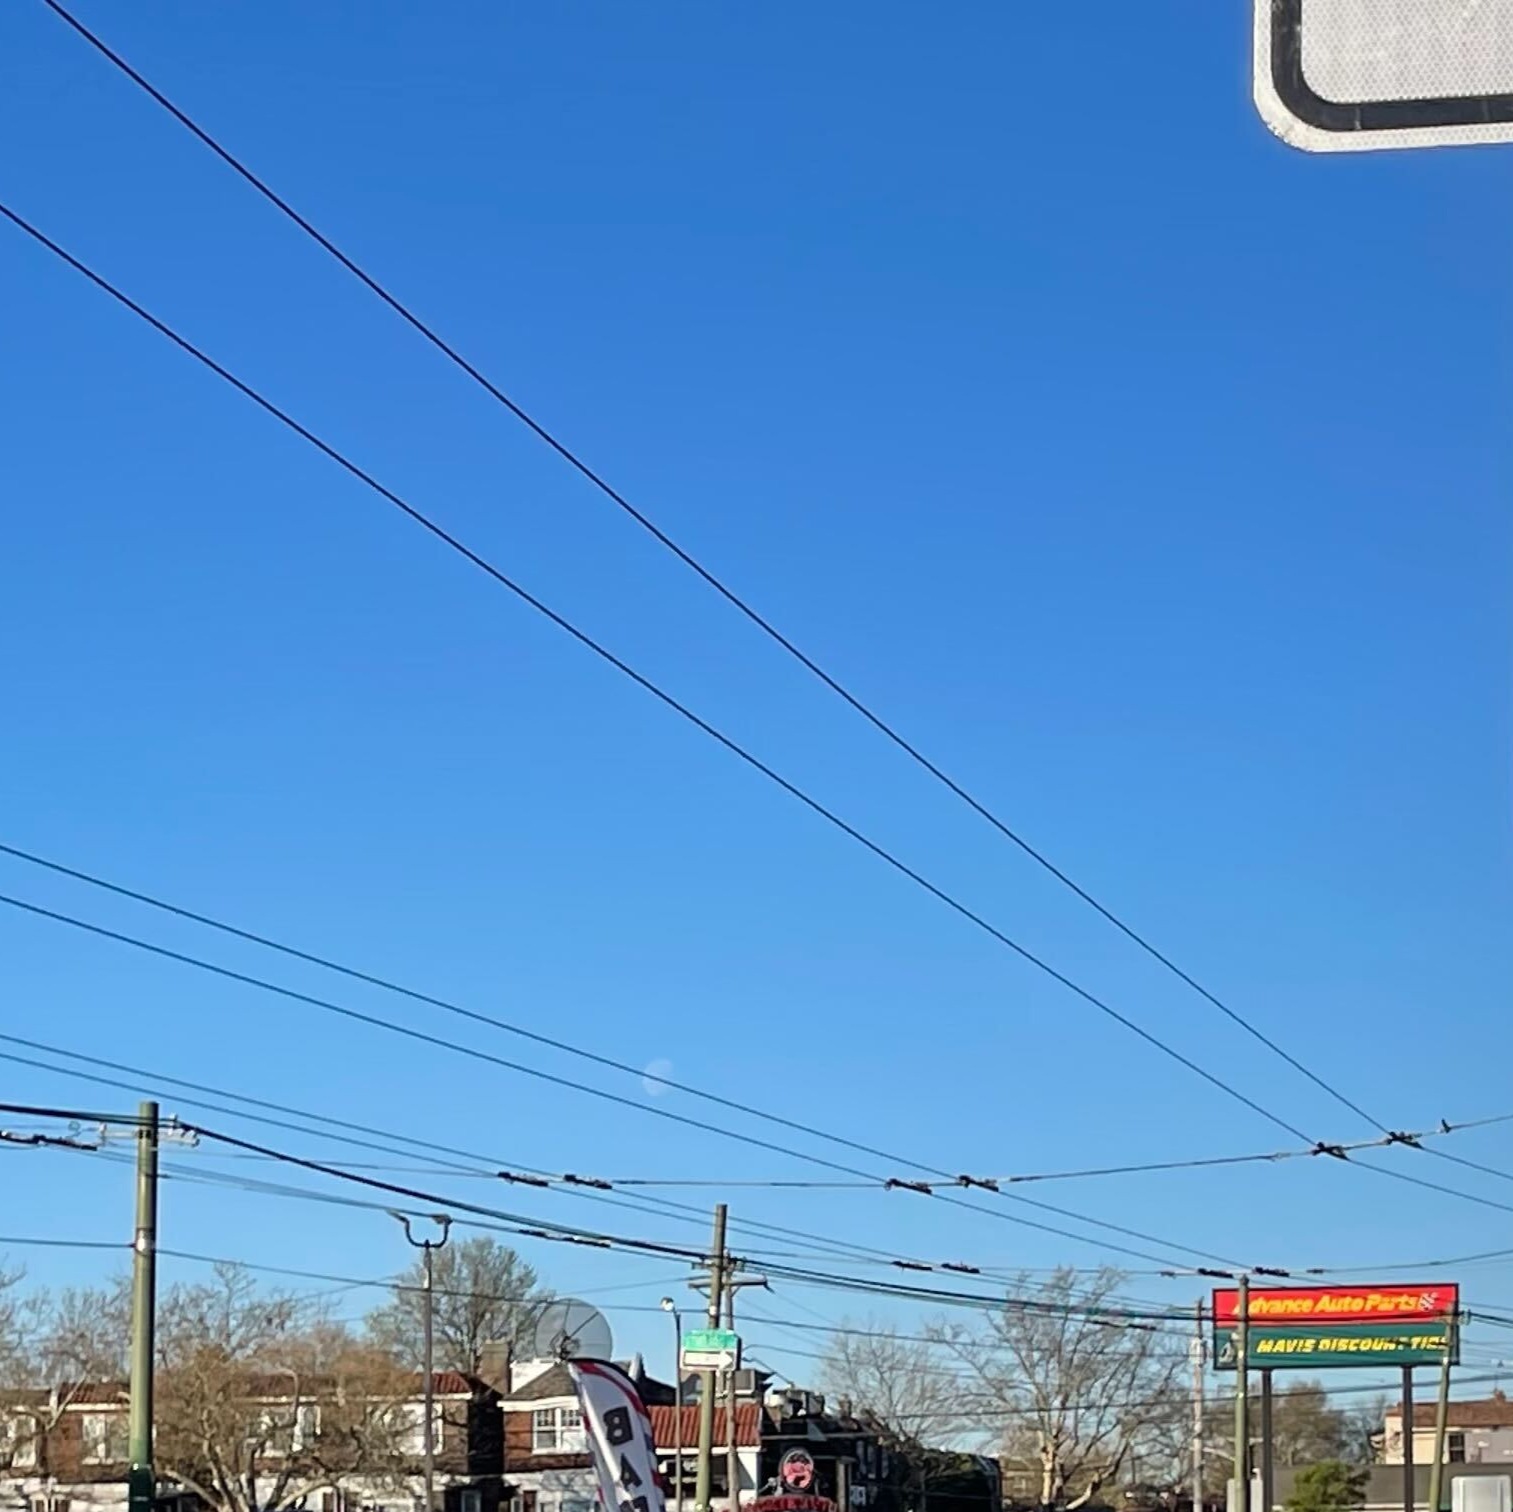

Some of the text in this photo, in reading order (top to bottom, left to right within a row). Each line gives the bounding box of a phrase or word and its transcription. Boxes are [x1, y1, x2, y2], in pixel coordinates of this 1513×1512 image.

[1313, 1294, 1364, 1313] Auto
[1363, 1292, 1420, 1312] Parts
[1256, 1338, 1316, 1354] MAVIS
